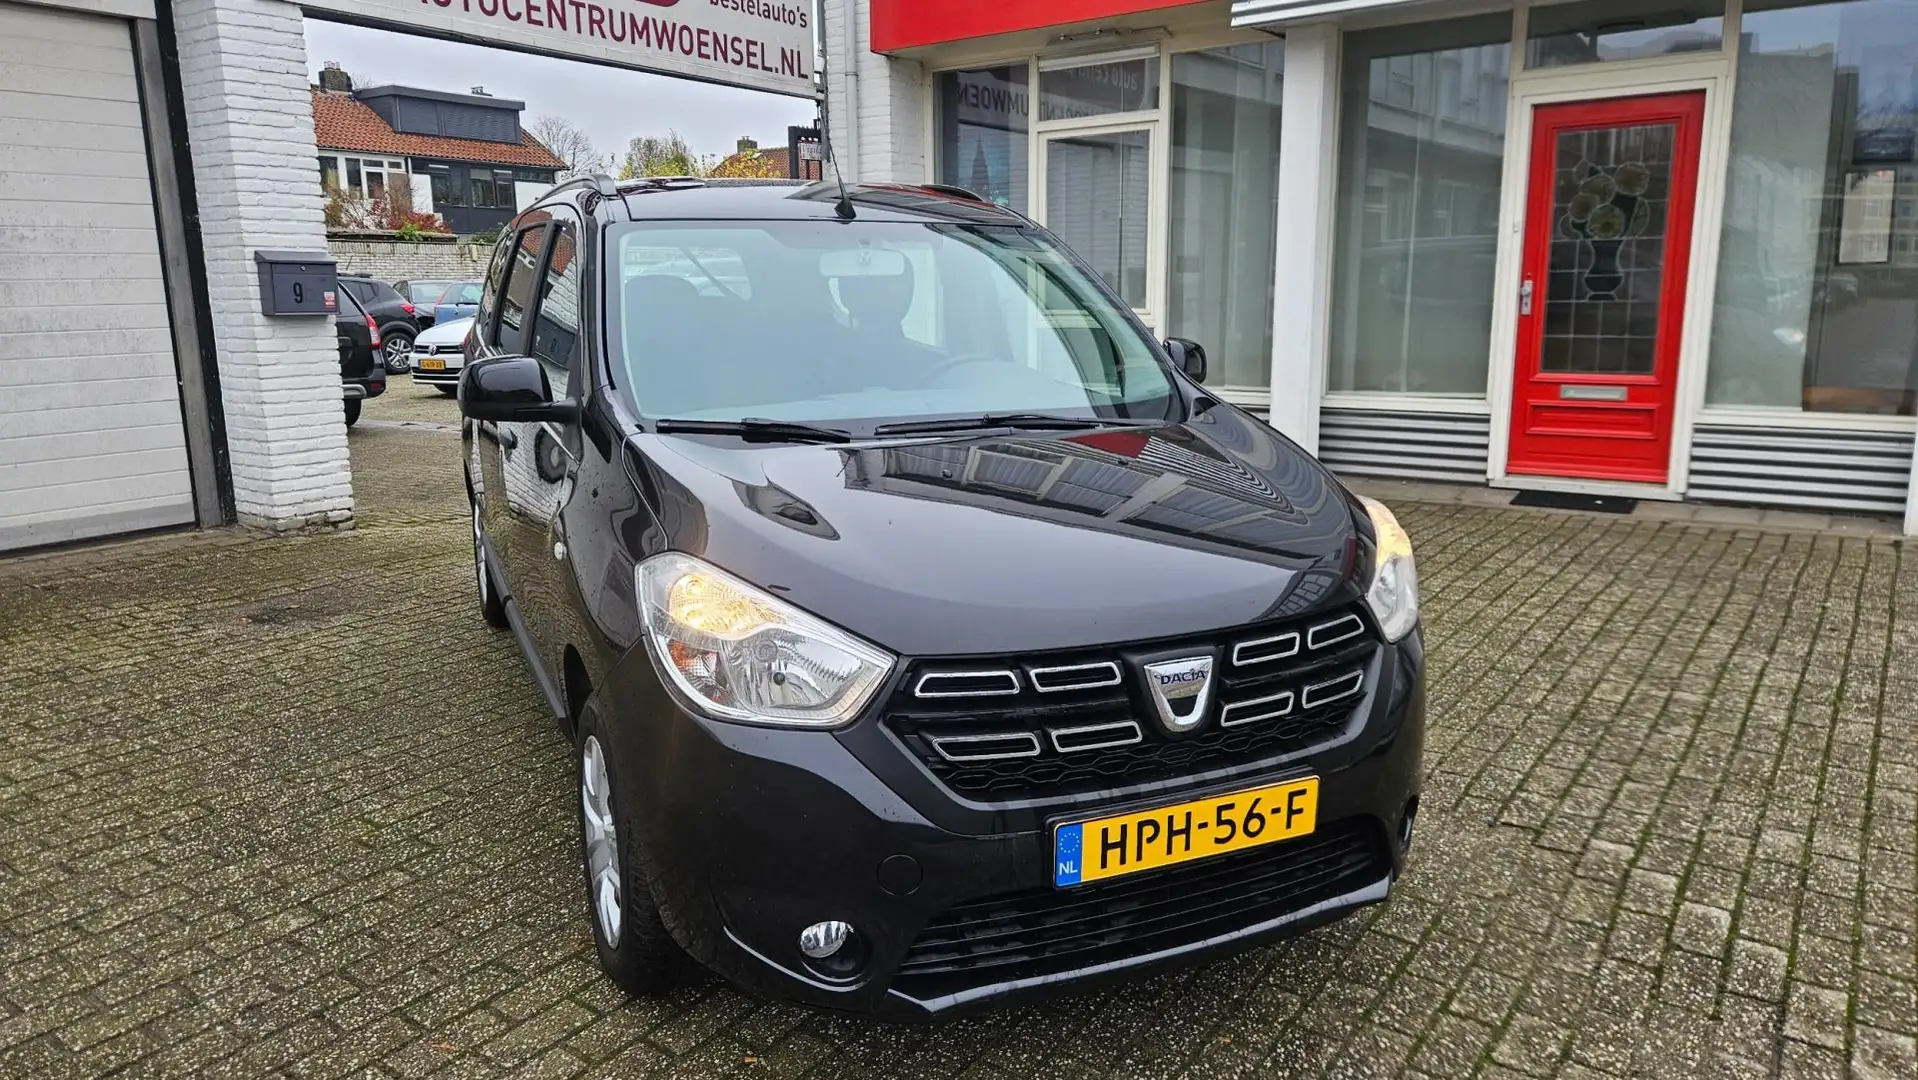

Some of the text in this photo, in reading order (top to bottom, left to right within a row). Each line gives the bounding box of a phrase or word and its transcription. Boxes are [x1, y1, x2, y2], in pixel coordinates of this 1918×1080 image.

[709, 0, 808, 28] estelauto's
[417, 0, 809, 80] OCENTRUMWOENSEL.NL
[293, 282, 303, 304] 9
[1160, 669, 1206, 685] DACIA
[1100, 788, 1308, 870] HPH-56-F
[1059, 860, 1079, 876] NL
